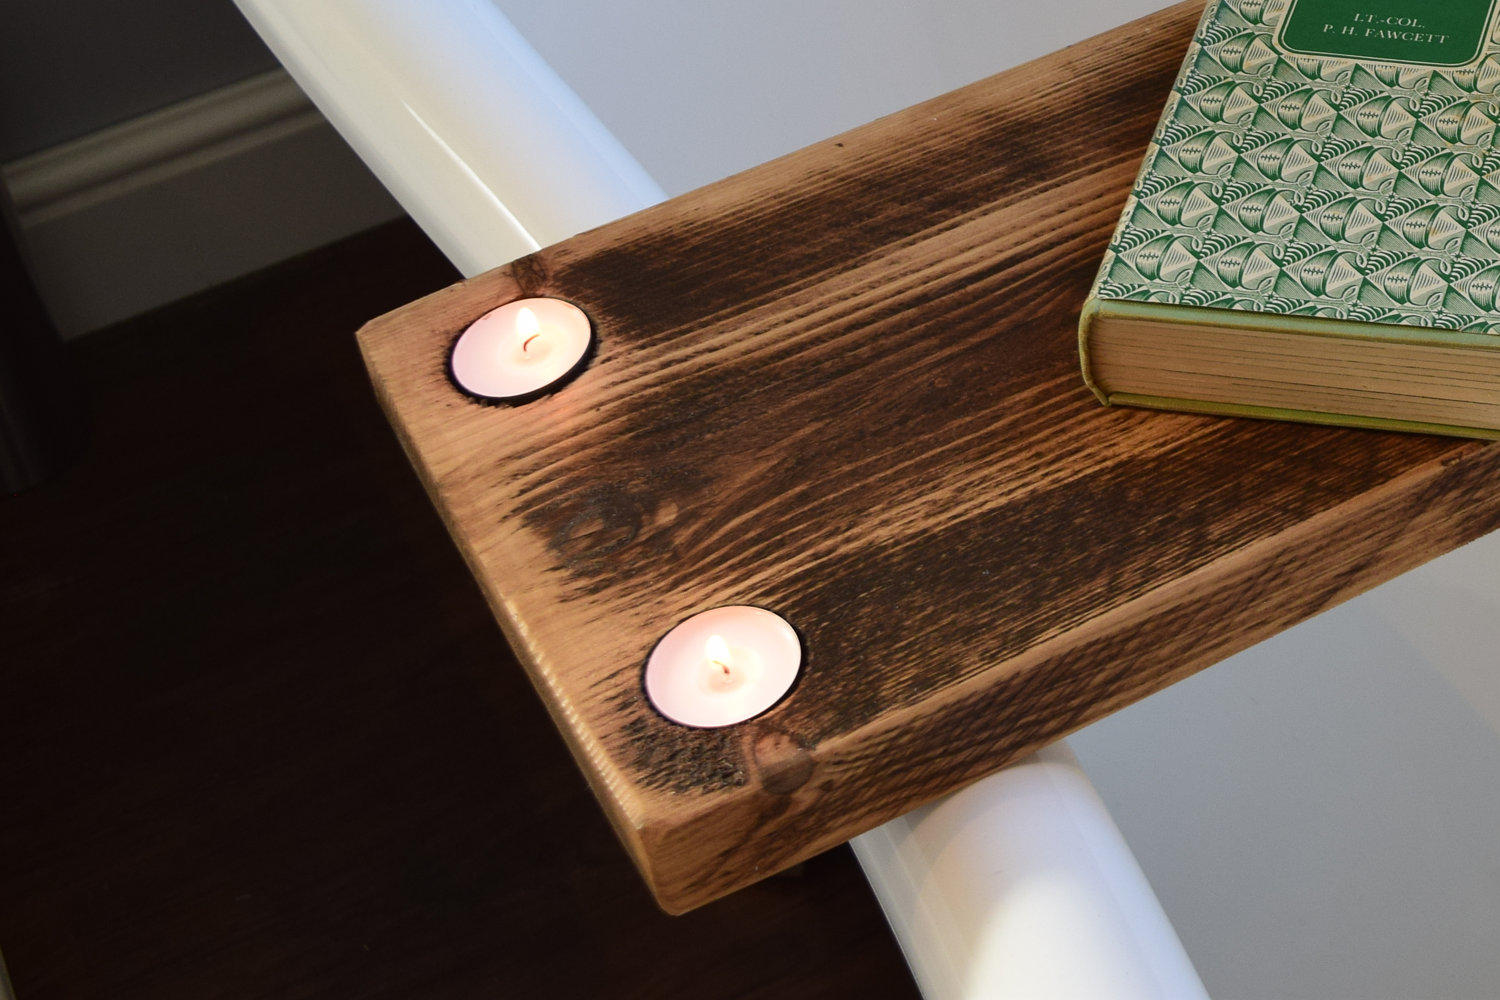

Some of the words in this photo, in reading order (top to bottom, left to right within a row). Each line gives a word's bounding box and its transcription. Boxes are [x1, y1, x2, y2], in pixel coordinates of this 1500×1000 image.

[1322, 23, 1336, 35] P.
[1341, 25, 1359, 36] H.
[1364, 28, 1450, 45] FAWCETT
